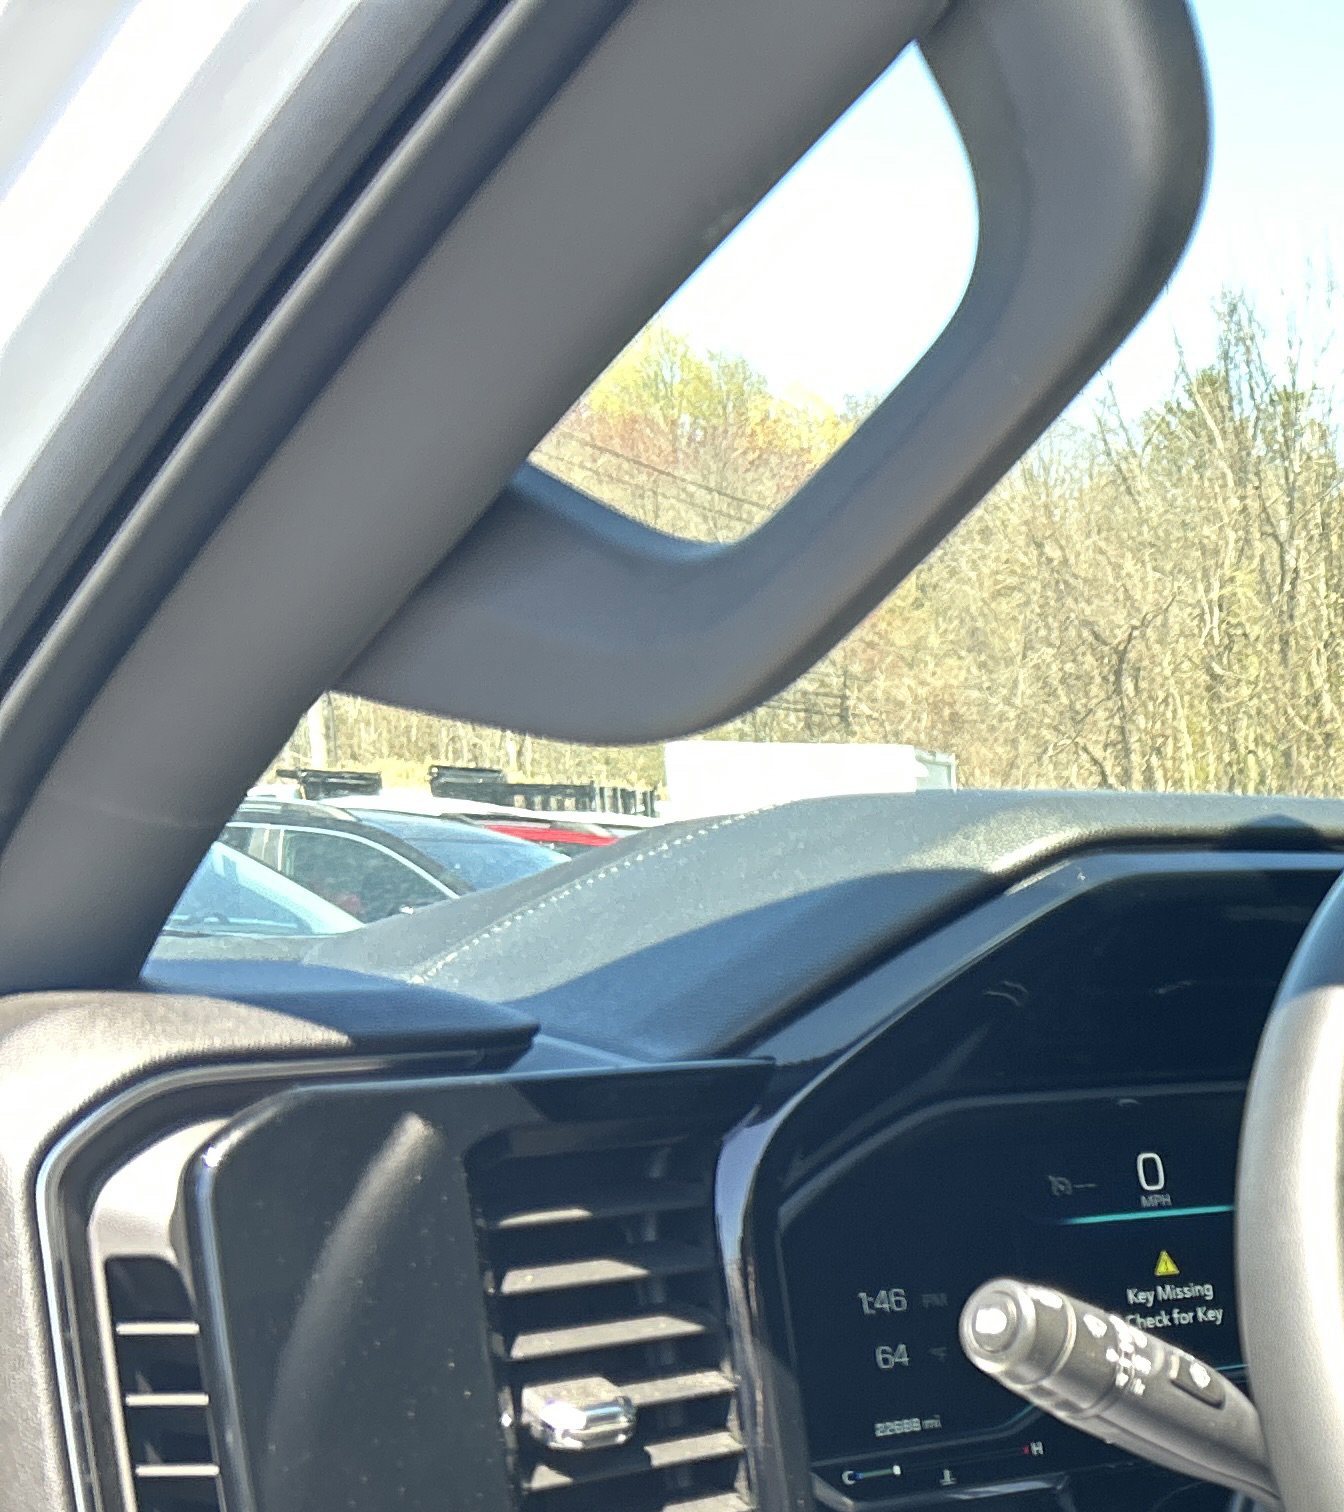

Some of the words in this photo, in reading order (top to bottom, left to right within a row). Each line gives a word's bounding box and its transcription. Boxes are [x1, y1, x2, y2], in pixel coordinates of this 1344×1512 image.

[1136, 1153, 1165, 1191] 0
[1140, 1194, 1173, 1208] MPH
[857, 1288, 908, 1315] 1:46
[1126, 1288, 1155, 1307] Key
[1156, 1283, 1213, 1301] Missing
[1171, 1308, 1194, 1324] for
[1196, 1306, 1223, 1325] Key
[875, 1343, 910, 1369] 64
